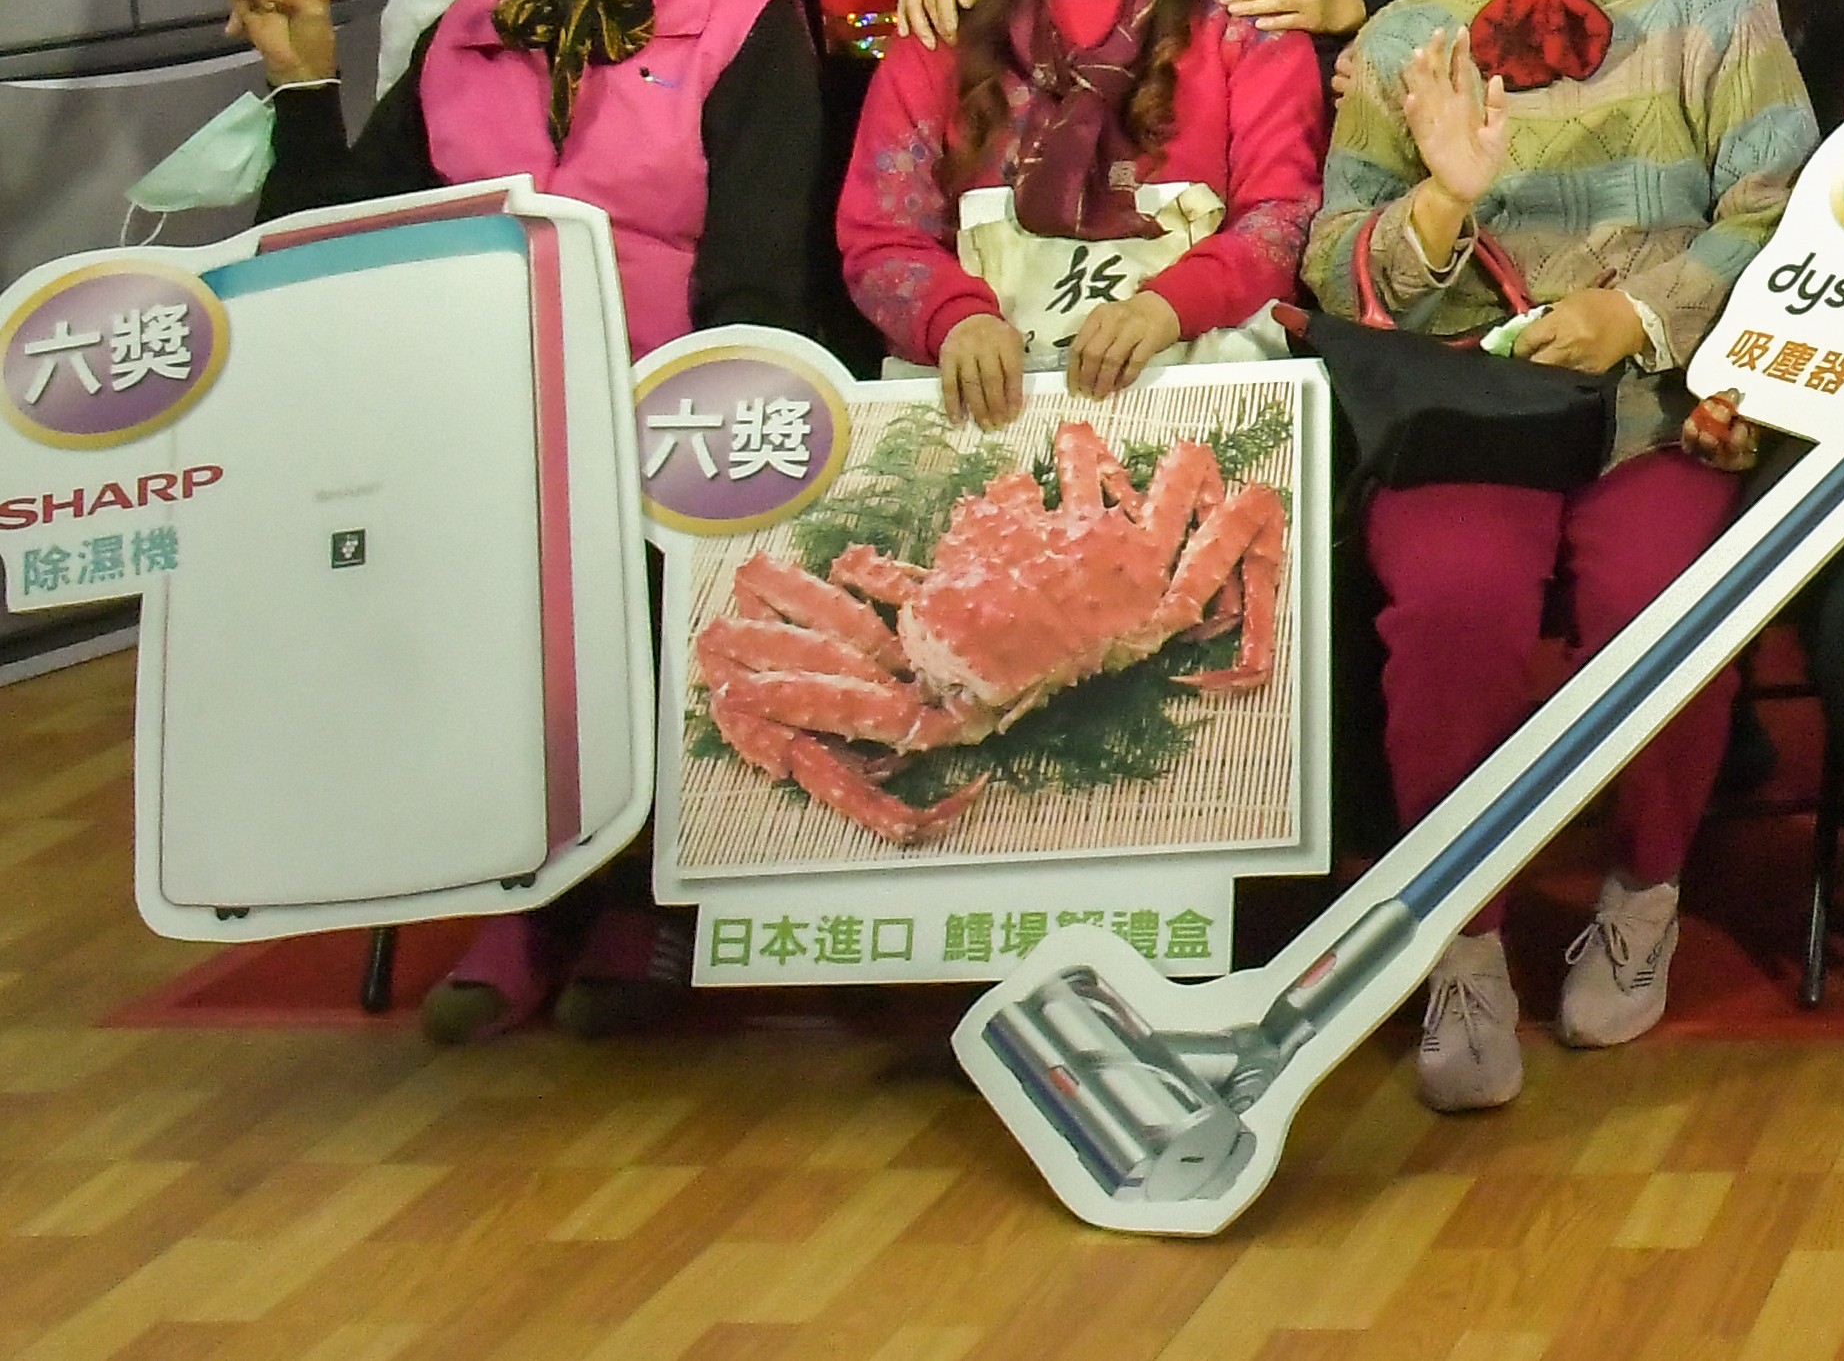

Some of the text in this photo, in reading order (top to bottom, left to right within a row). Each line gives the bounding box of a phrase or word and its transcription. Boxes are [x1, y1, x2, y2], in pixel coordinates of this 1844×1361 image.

[22, 300, 193, 407] 六獎
[642, 395, 813, 483] 六獎
[0, 465, 224, 530] SHARP
[22, 523, 181, 595] 除濕機
[708, 913, 916, 970] 日本進口
